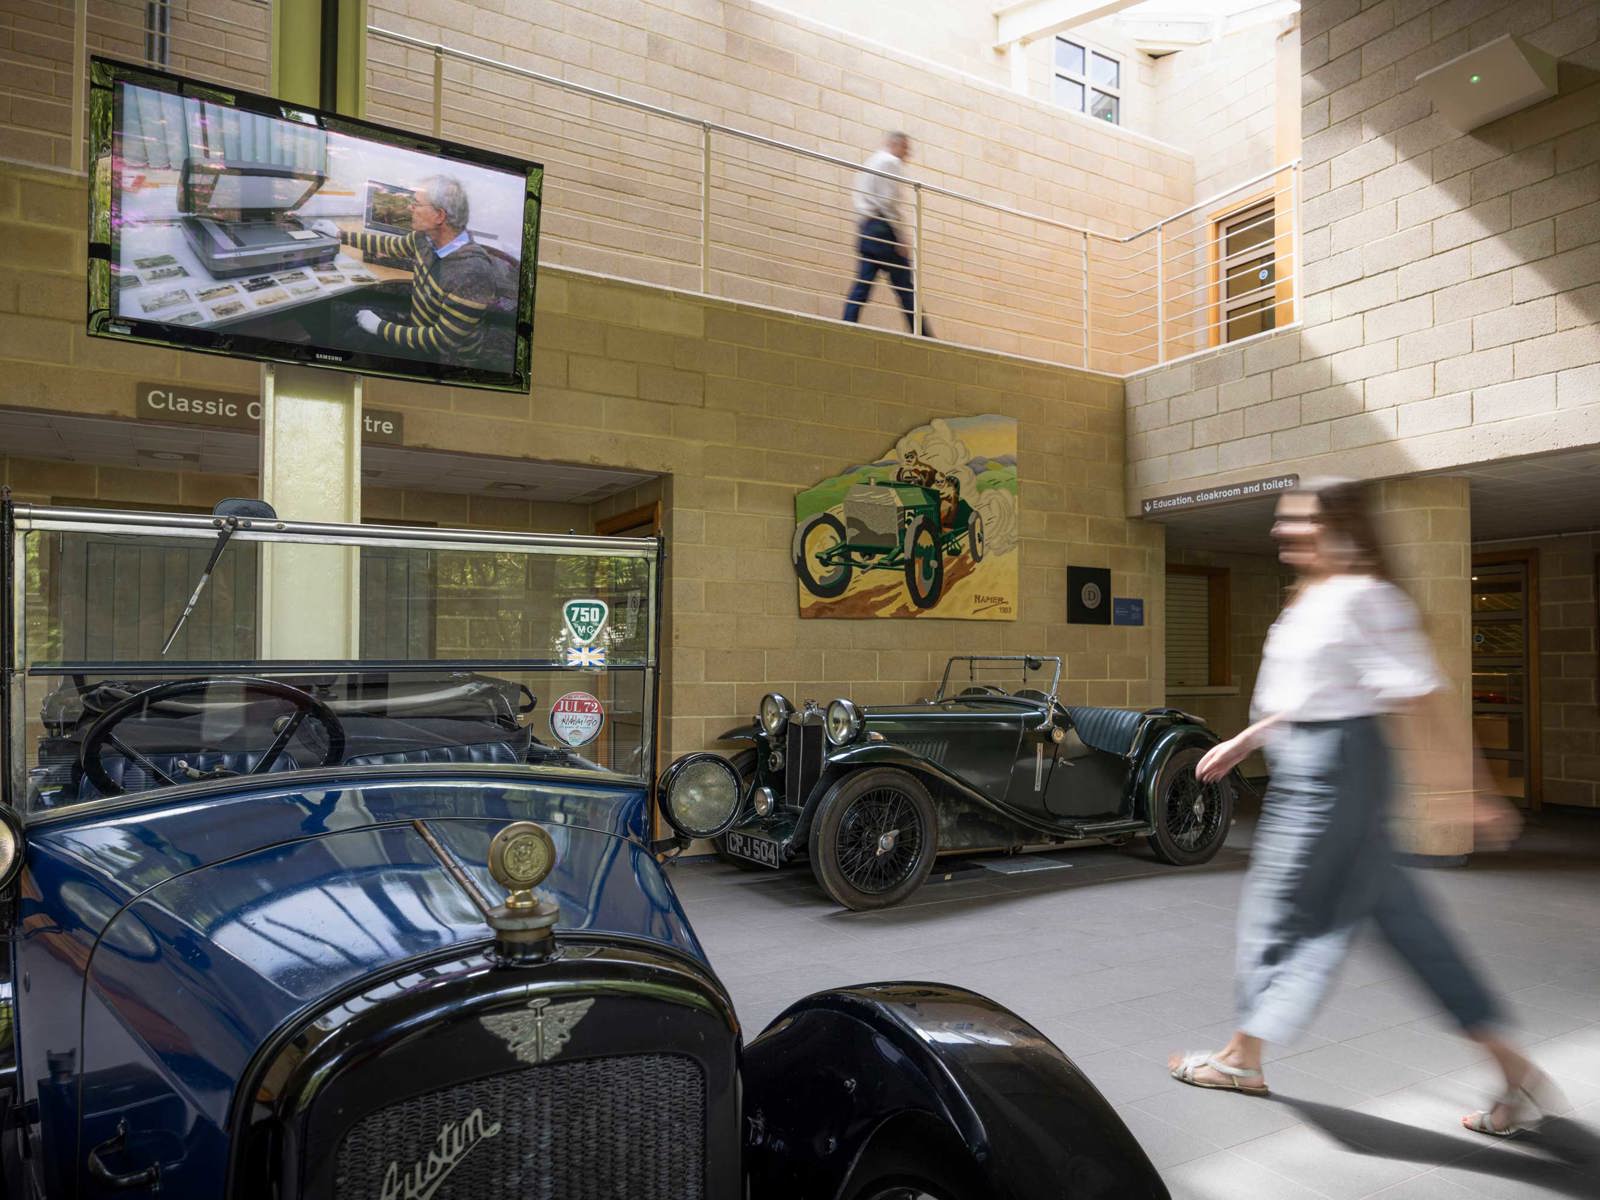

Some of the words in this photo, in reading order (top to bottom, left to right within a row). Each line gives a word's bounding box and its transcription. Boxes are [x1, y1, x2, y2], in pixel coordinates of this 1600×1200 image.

[315, 353, 343, 362] SAMSUNG
[147, 390, 238, 418] Classic
[363, 415, 394, 434] tre
[1152, 496, 1194, 509] Education,
[1196, 487, 1241, 502] cloakroom
[1243, 483, 1260, 494] and
[1262, 478, 1294, 491] toilets
[570, 607, 600, 622] 750
[557, 700, 582, 712] JUL
[583, 702, 599, 713] 72
[729, 833, 751, 857] CPJ
[752, 839, 776, 865] 504
[379, 1108, 502, 1200] Austin
